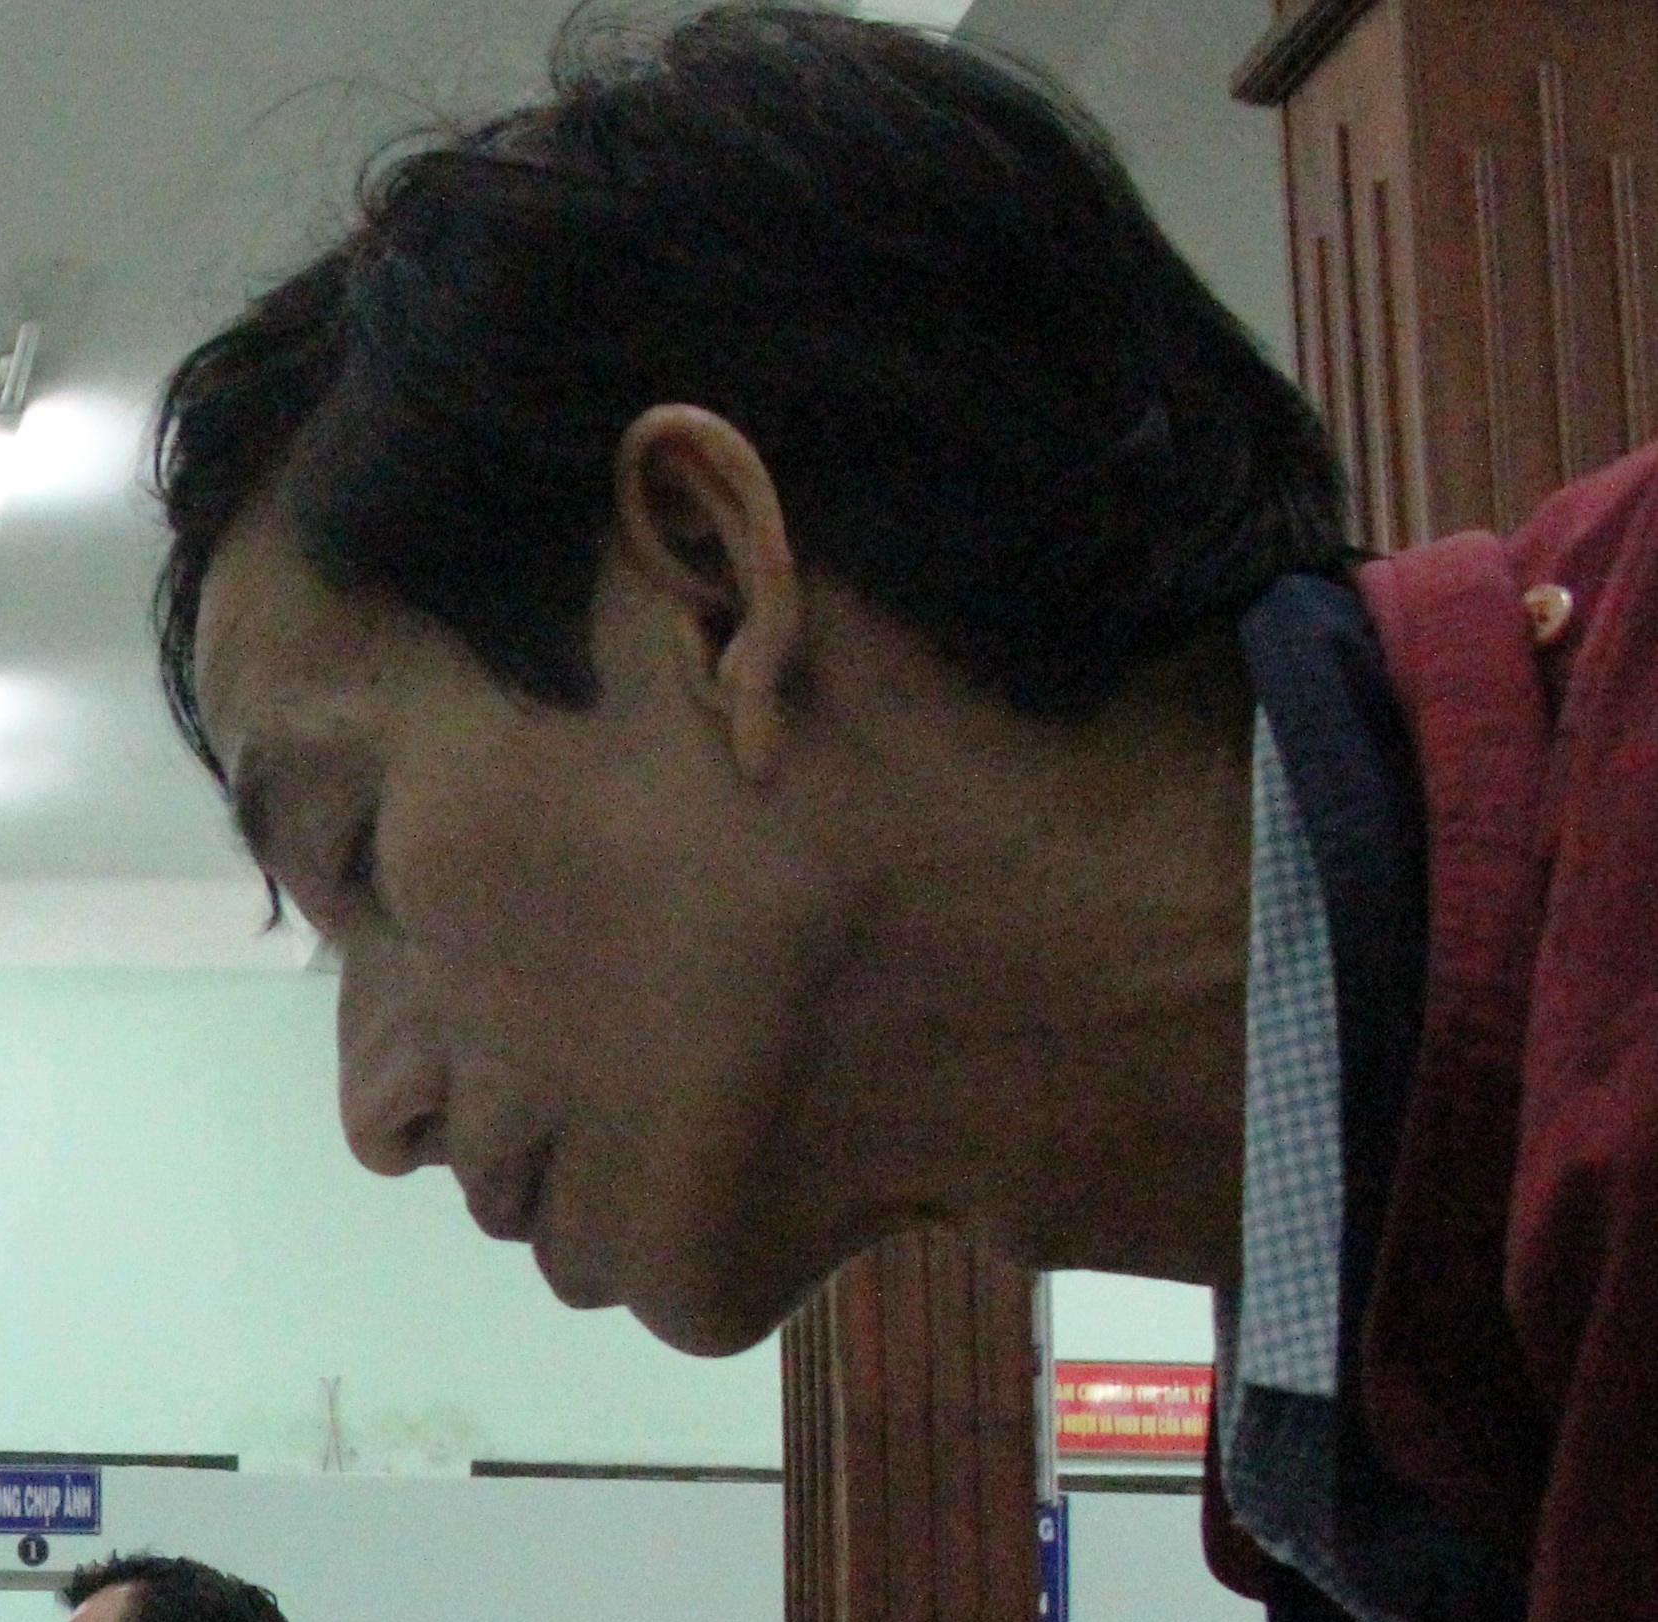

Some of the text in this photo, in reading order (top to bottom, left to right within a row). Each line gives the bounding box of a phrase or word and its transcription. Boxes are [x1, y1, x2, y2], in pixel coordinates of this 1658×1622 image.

[24, 1484, 62, 1527] CHỤP
[63, 1474, 93, 1518] ẢNH
[27, 1540, 39, 1561] 1
